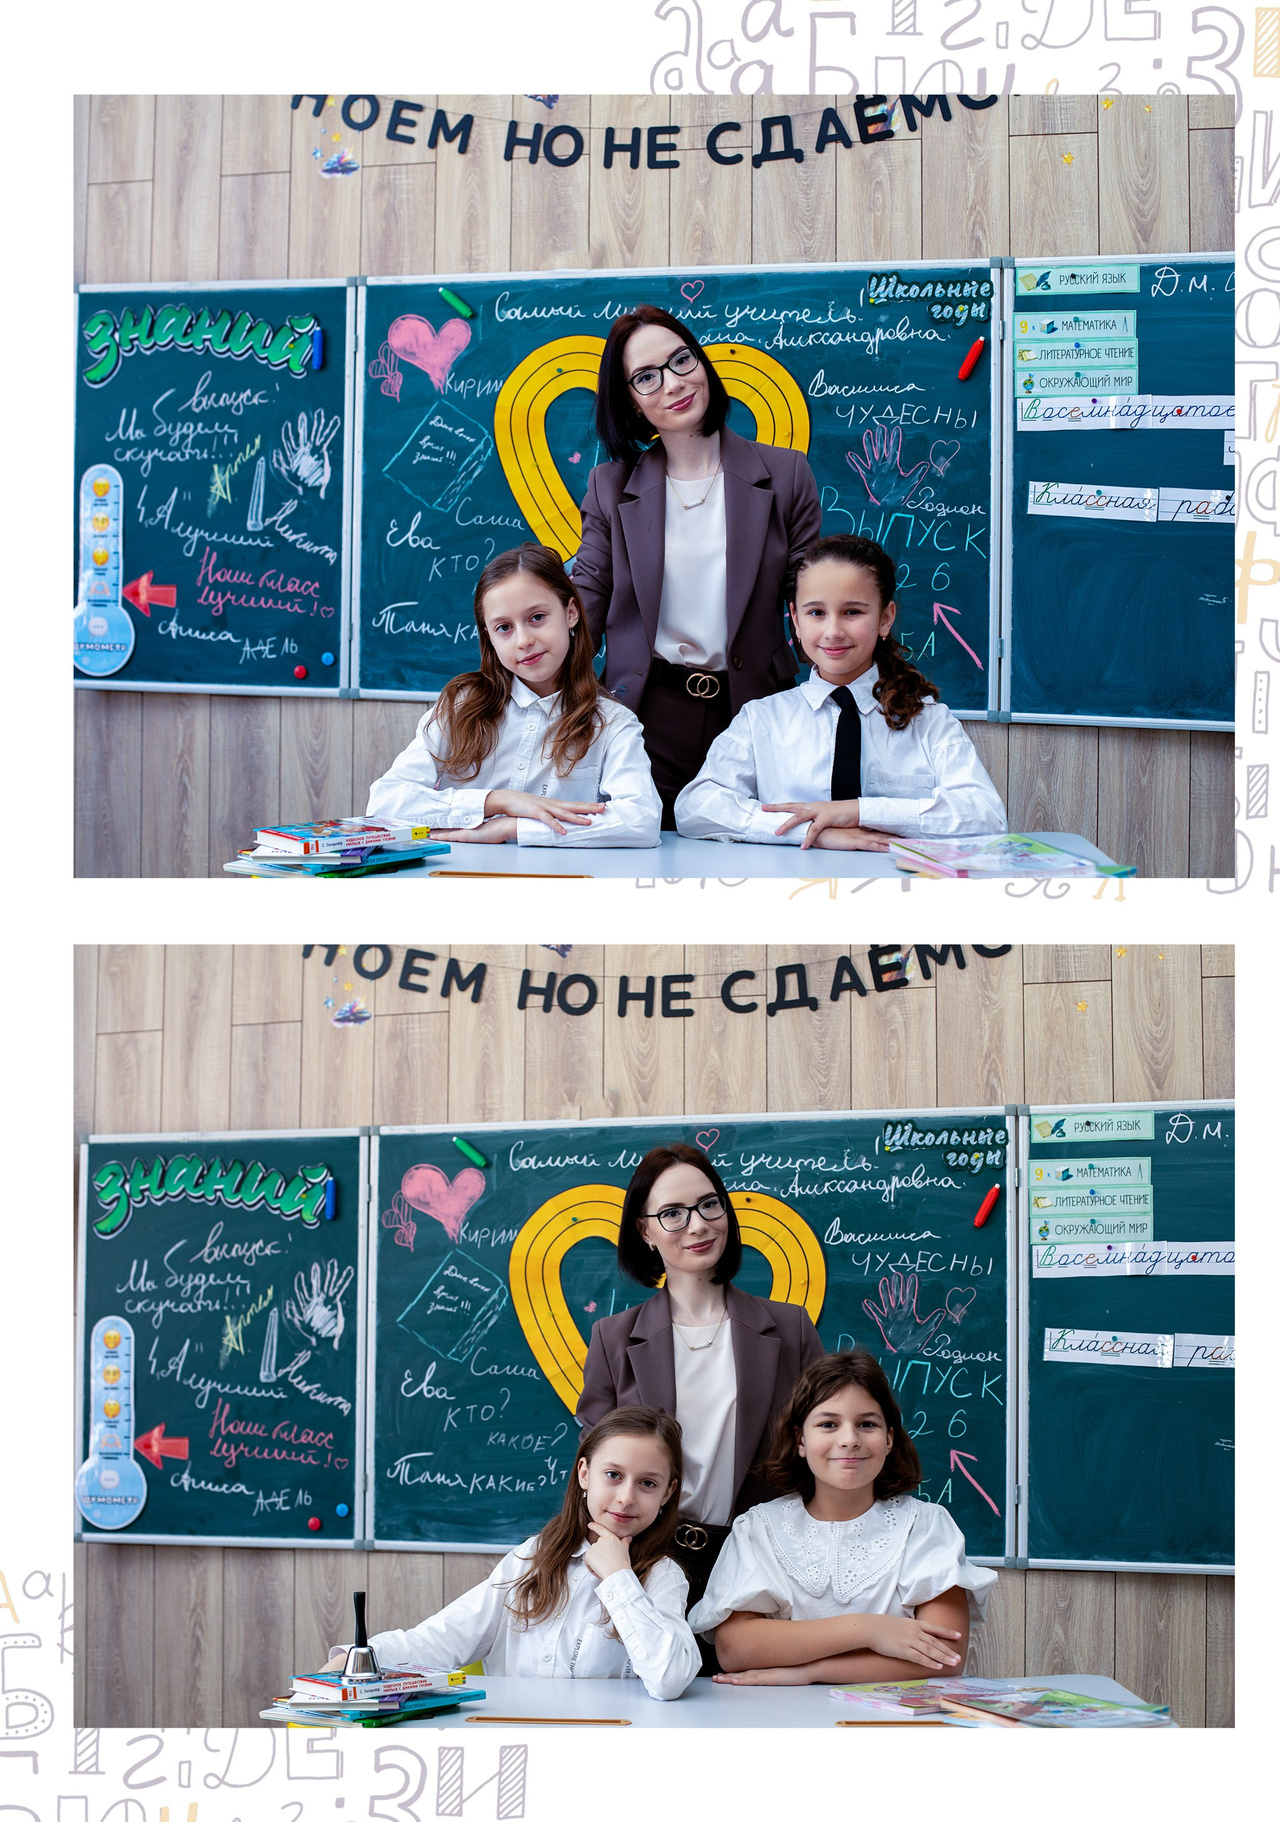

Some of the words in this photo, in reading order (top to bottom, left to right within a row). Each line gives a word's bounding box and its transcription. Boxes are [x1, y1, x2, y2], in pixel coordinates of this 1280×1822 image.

[504, 120, 583, 168] НО
[602, 125, 680, 169] НЕ
[706, 95, 1004, 168] СДАЁМ
[1059, 272, 1099, 286] РУССКИЙ
[1102, 273, 1127, 284] ЯЗЫК
[930, 302, 988, 327] годы
[1061, 319, 1117, 331] МАТЕМАТИКА
[1039, 348, 1102, 360] ЛИТЕРАТУРНОЕ
[1104, 347, 1135, 359] ЧТЕНИЕ
[1039, 374, 1111, 390] ОКРУЖАЮЩИЙ
[1113, 376, 1133, 387] МИР
[836, 403, 977, 428] ЧУДЕСНЫ
[456, 497, 525, 530] Саша
[820, 486, 986, 558] ВЫПУСК
[386, 511, 441, 549] Ева
[517, 969, 598, 1016] НО
[618, 974, 694, 1018] НЕ
[1074, 1119, 1114, 1133] РУССКИЙ
[1116, 1120, 1141, 1131] ЯЗЫК
[946, 1150, 1002, 1174] годы
[1076, 1167, 1132, 1178] МАТЕМАТИКА
[1054, 1195, 1117, 1207] ЛИТЕРАТУРНОЕ
[1119, 1194, 1150, 1205] ЧТЕНИЕ
[1054, 1221, 1125, 1236] ОКРУЖАЮЩИЙ
[1129, 1223, 1148, 1233] МИР
[852, 1251, 992, 1276] ЧУДЕСНЫ
[471, 1347, 541, 1380] Саша
[401, 1361, 456, 1400] Ева
[444, 1388, 510, 1432] КТО?
[487, 1422, 567, 1453] КАКОЕ?
